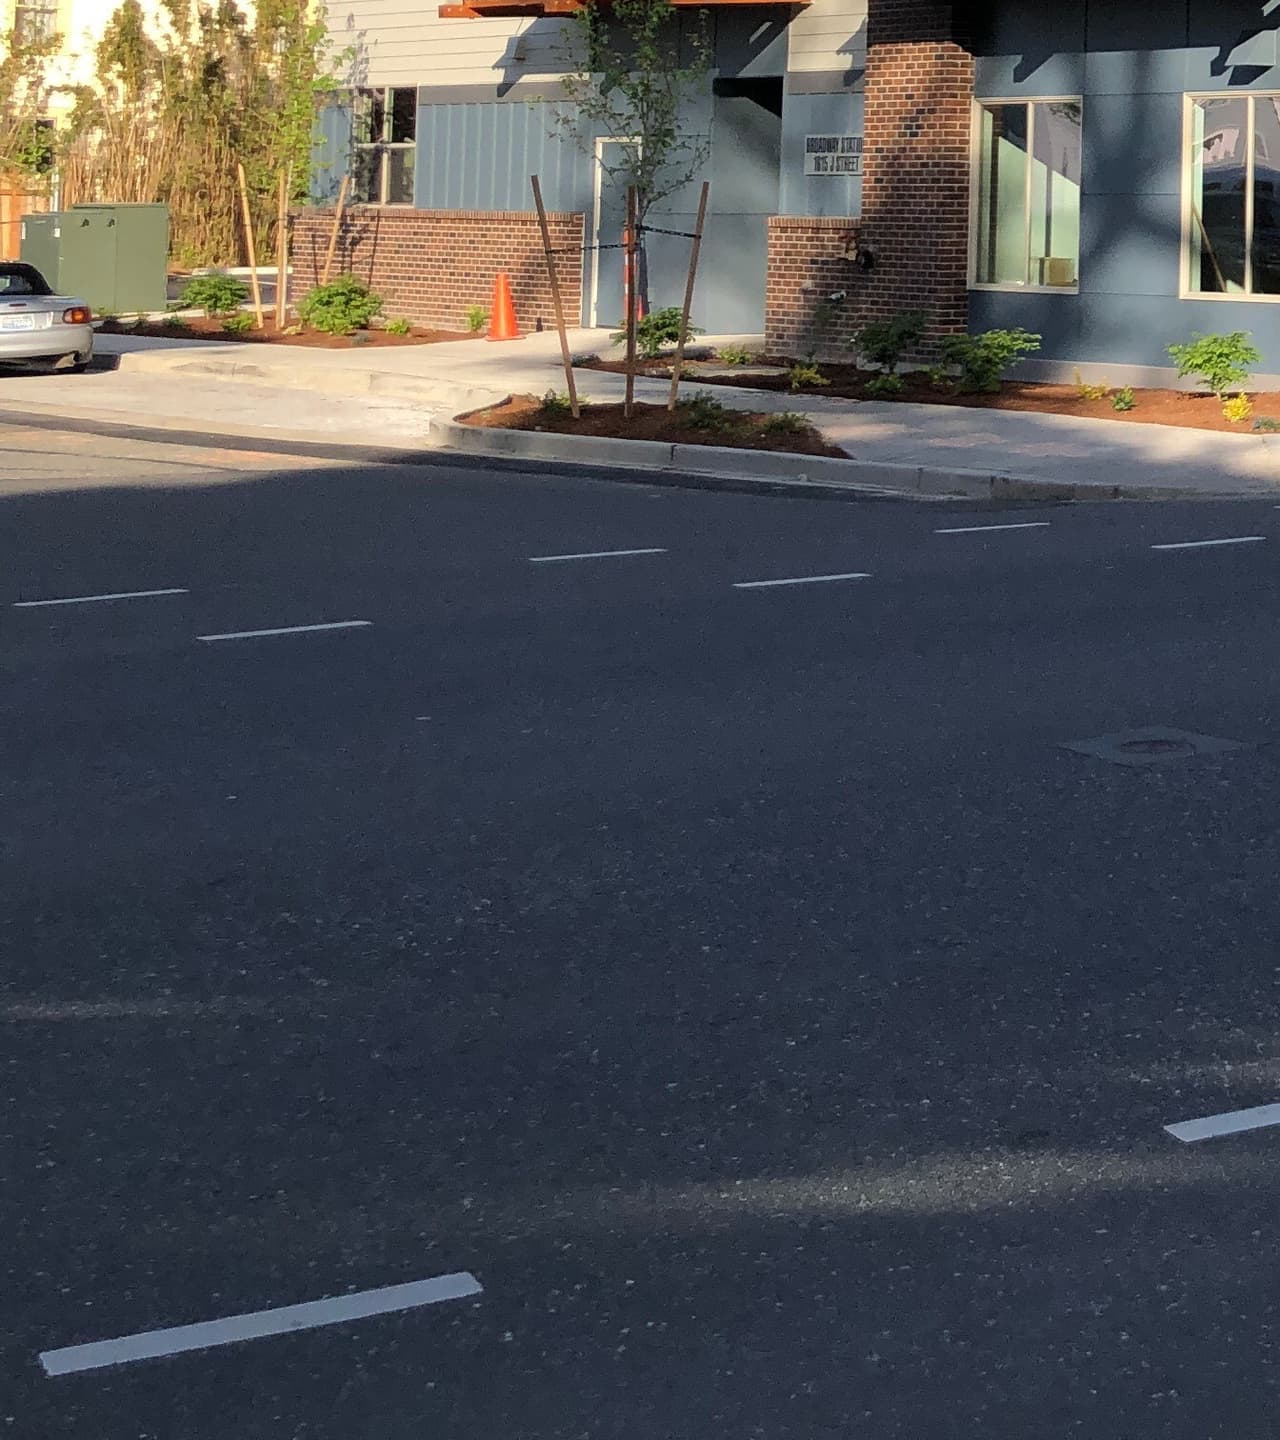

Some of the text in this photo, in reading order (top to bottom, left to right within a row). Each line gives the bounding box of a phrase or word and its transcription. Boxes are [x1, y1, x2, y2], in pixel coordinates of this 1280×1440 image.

[806, 137, 863, 153] BROADWAY STATIO
[836, 156, 860, 172] STREET
